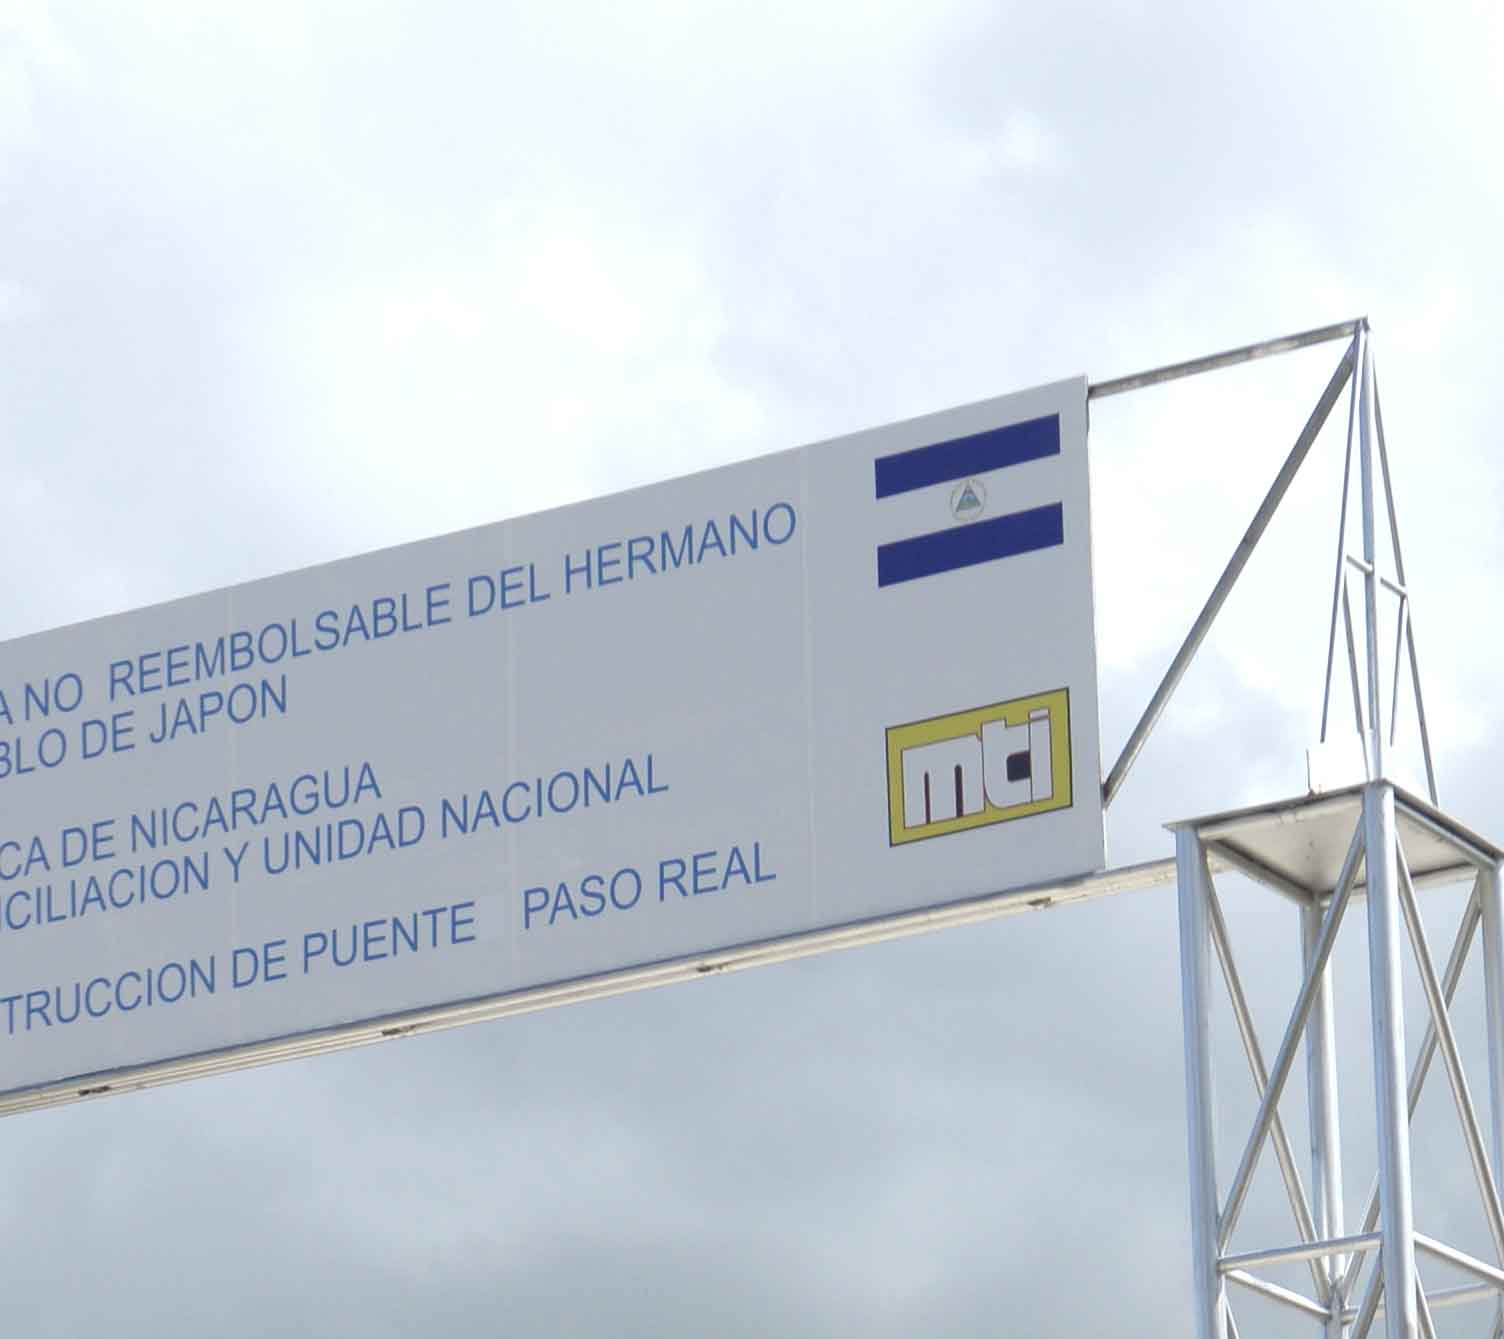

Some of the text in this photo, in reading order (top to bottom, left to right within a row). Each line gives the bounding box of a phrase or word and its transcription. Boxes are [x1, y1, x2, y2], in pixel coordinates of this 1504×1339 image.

[24, 672, 84, 721] NO
[109, 583, 452, 702] REEMBOLSABLE
[467, 562, 551, 618] DEL
[564, 501, 797, 595] HERMANO
[80, 709, 136, 761] DE
[149, 673, 287, 745] JAPON
[901, 708, 1053, 830] mti
[61, 818, 117, 869] DE
[130, 761, 383, 853] NICARAGUA
[223, 841, 249, 884] Y
[263, 805, 426, 875] UNIDAD
[441, 753, 670, 839] NACIONAL
[231, 938, 288, 990] DE
[303, 900, 477, 975] PUENTE
[523, 867, 643, 931] PASO
[658, 841, 777, 903] REAL
